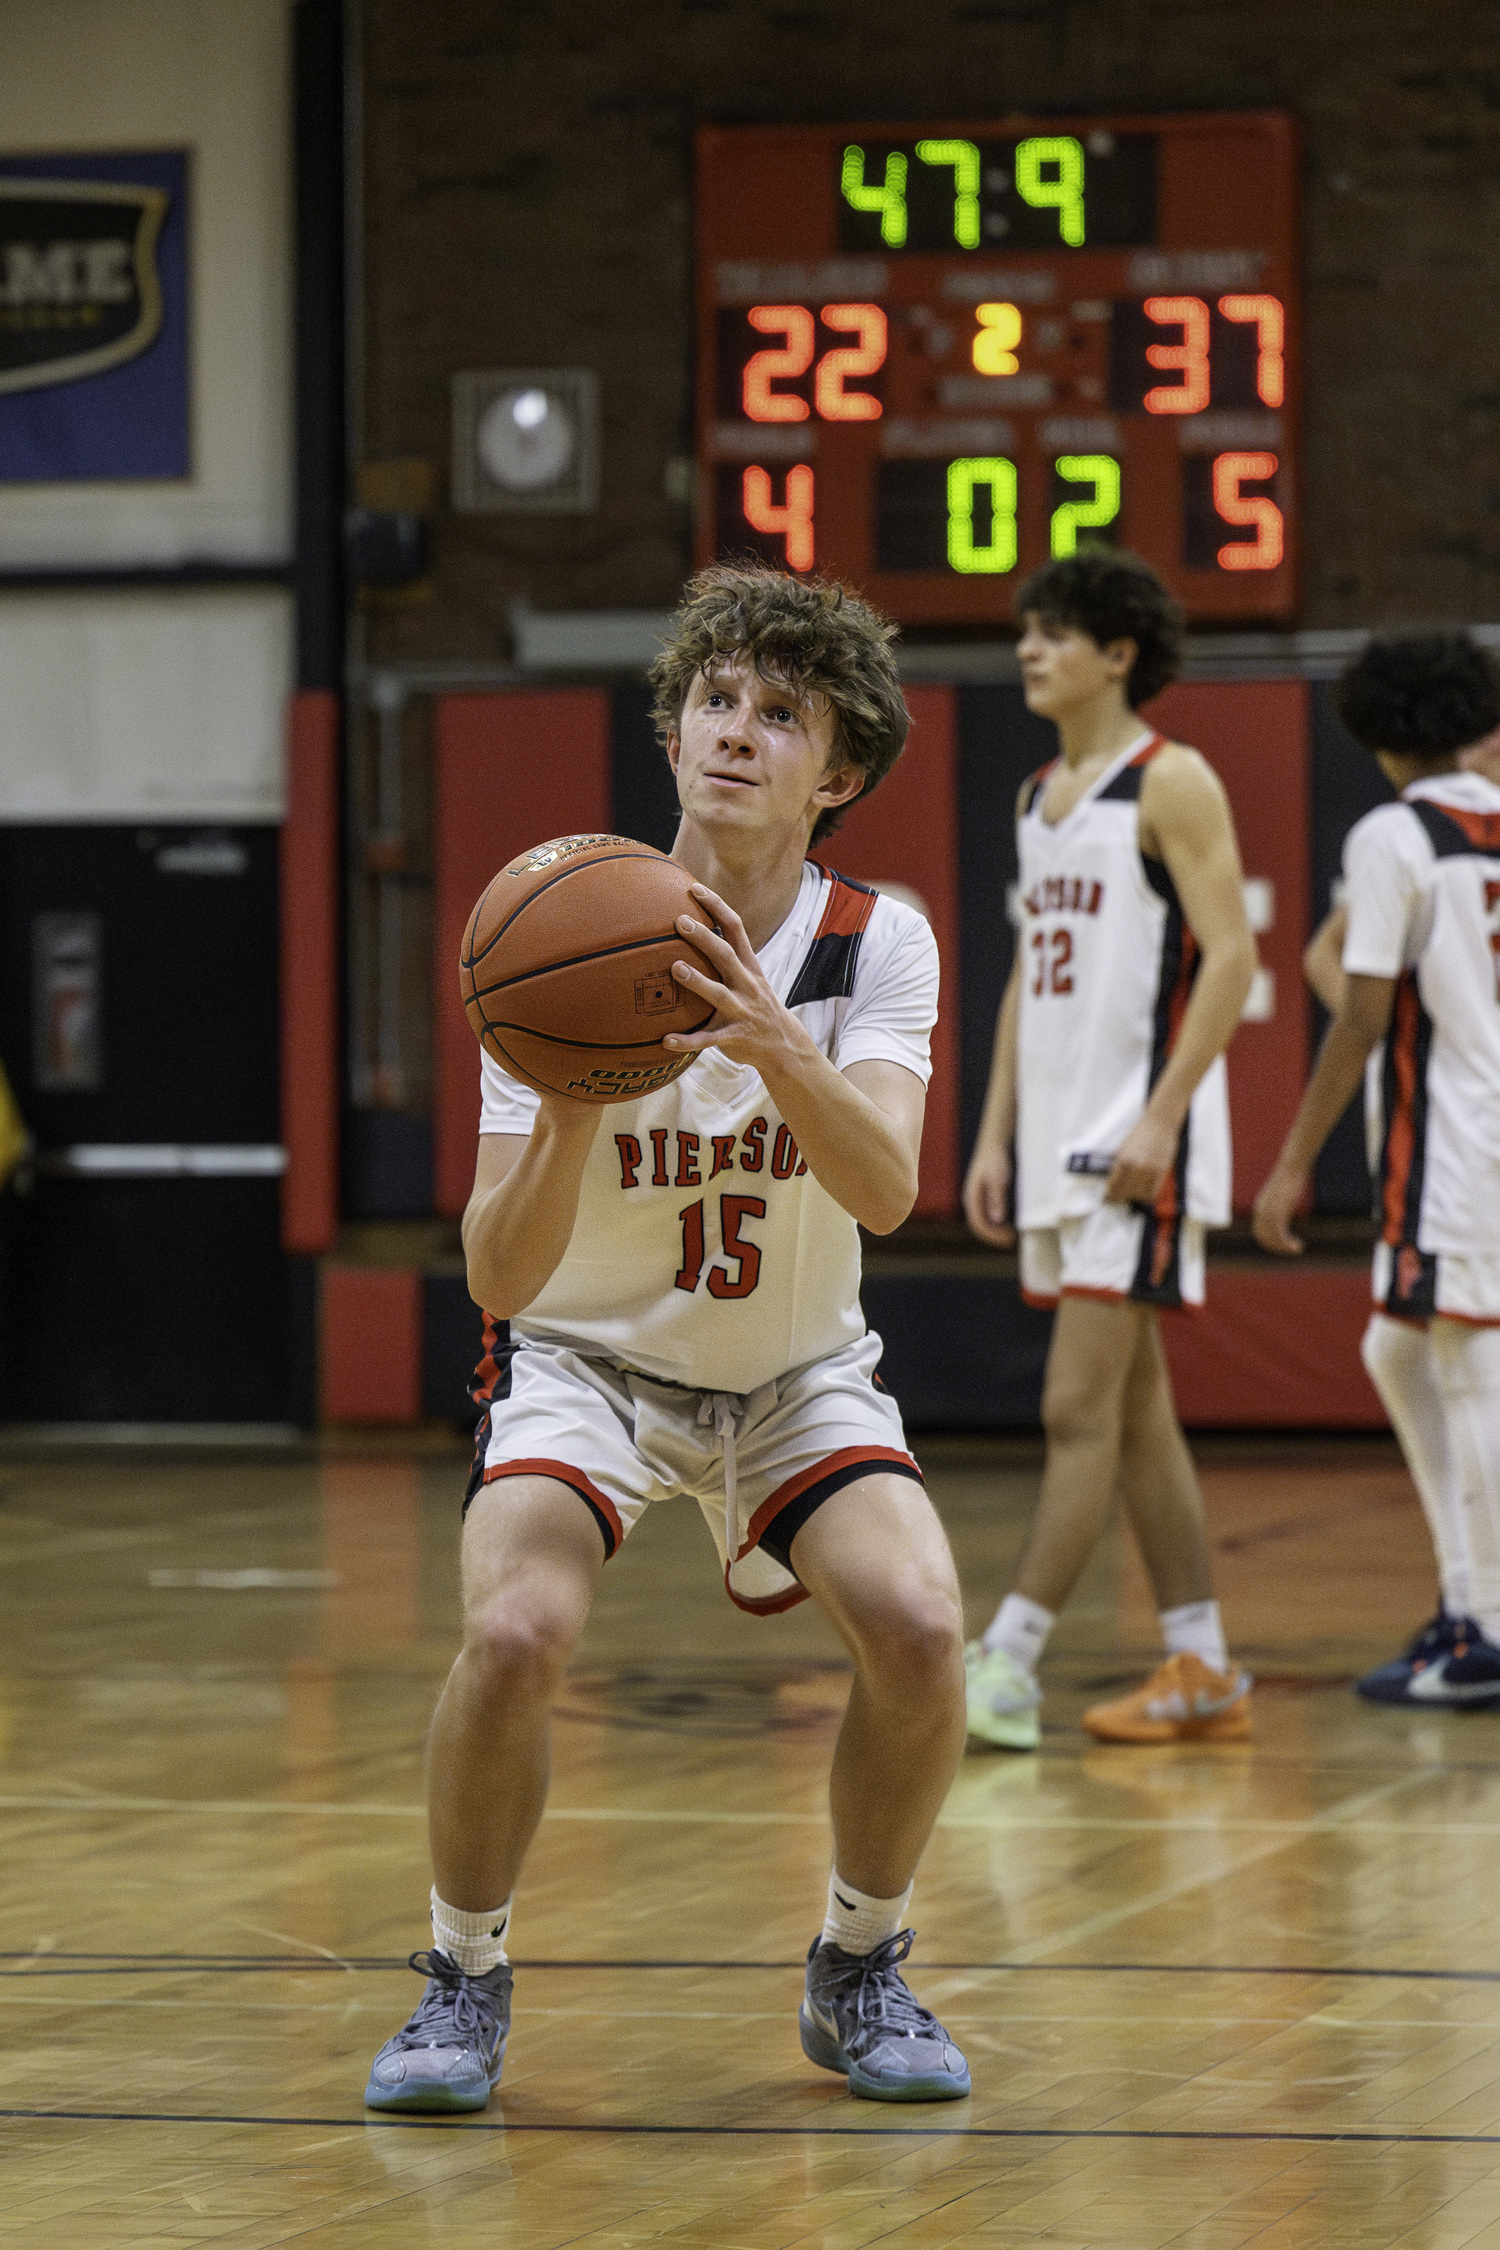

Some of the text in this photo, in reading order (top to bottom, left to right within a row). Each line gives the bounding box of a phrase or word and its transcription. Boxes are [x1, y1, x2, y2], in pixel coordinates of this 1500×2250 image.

[743, 303, 888, 422] 22
[973, 303, 1022, 375] 2
[1143, 294, 1284, 414] 37
[743, 464, 815, 572] 4
[947, 457, 1018, 573] 0
[1051, 454, 1121, 561] 2
[1213, 451, 1284, 570] 5
[566, 1070, 682, 1095] GACY
[614, 1116, 808, 1189] PIERSO
[674, 1194, 767, 1299] 15
